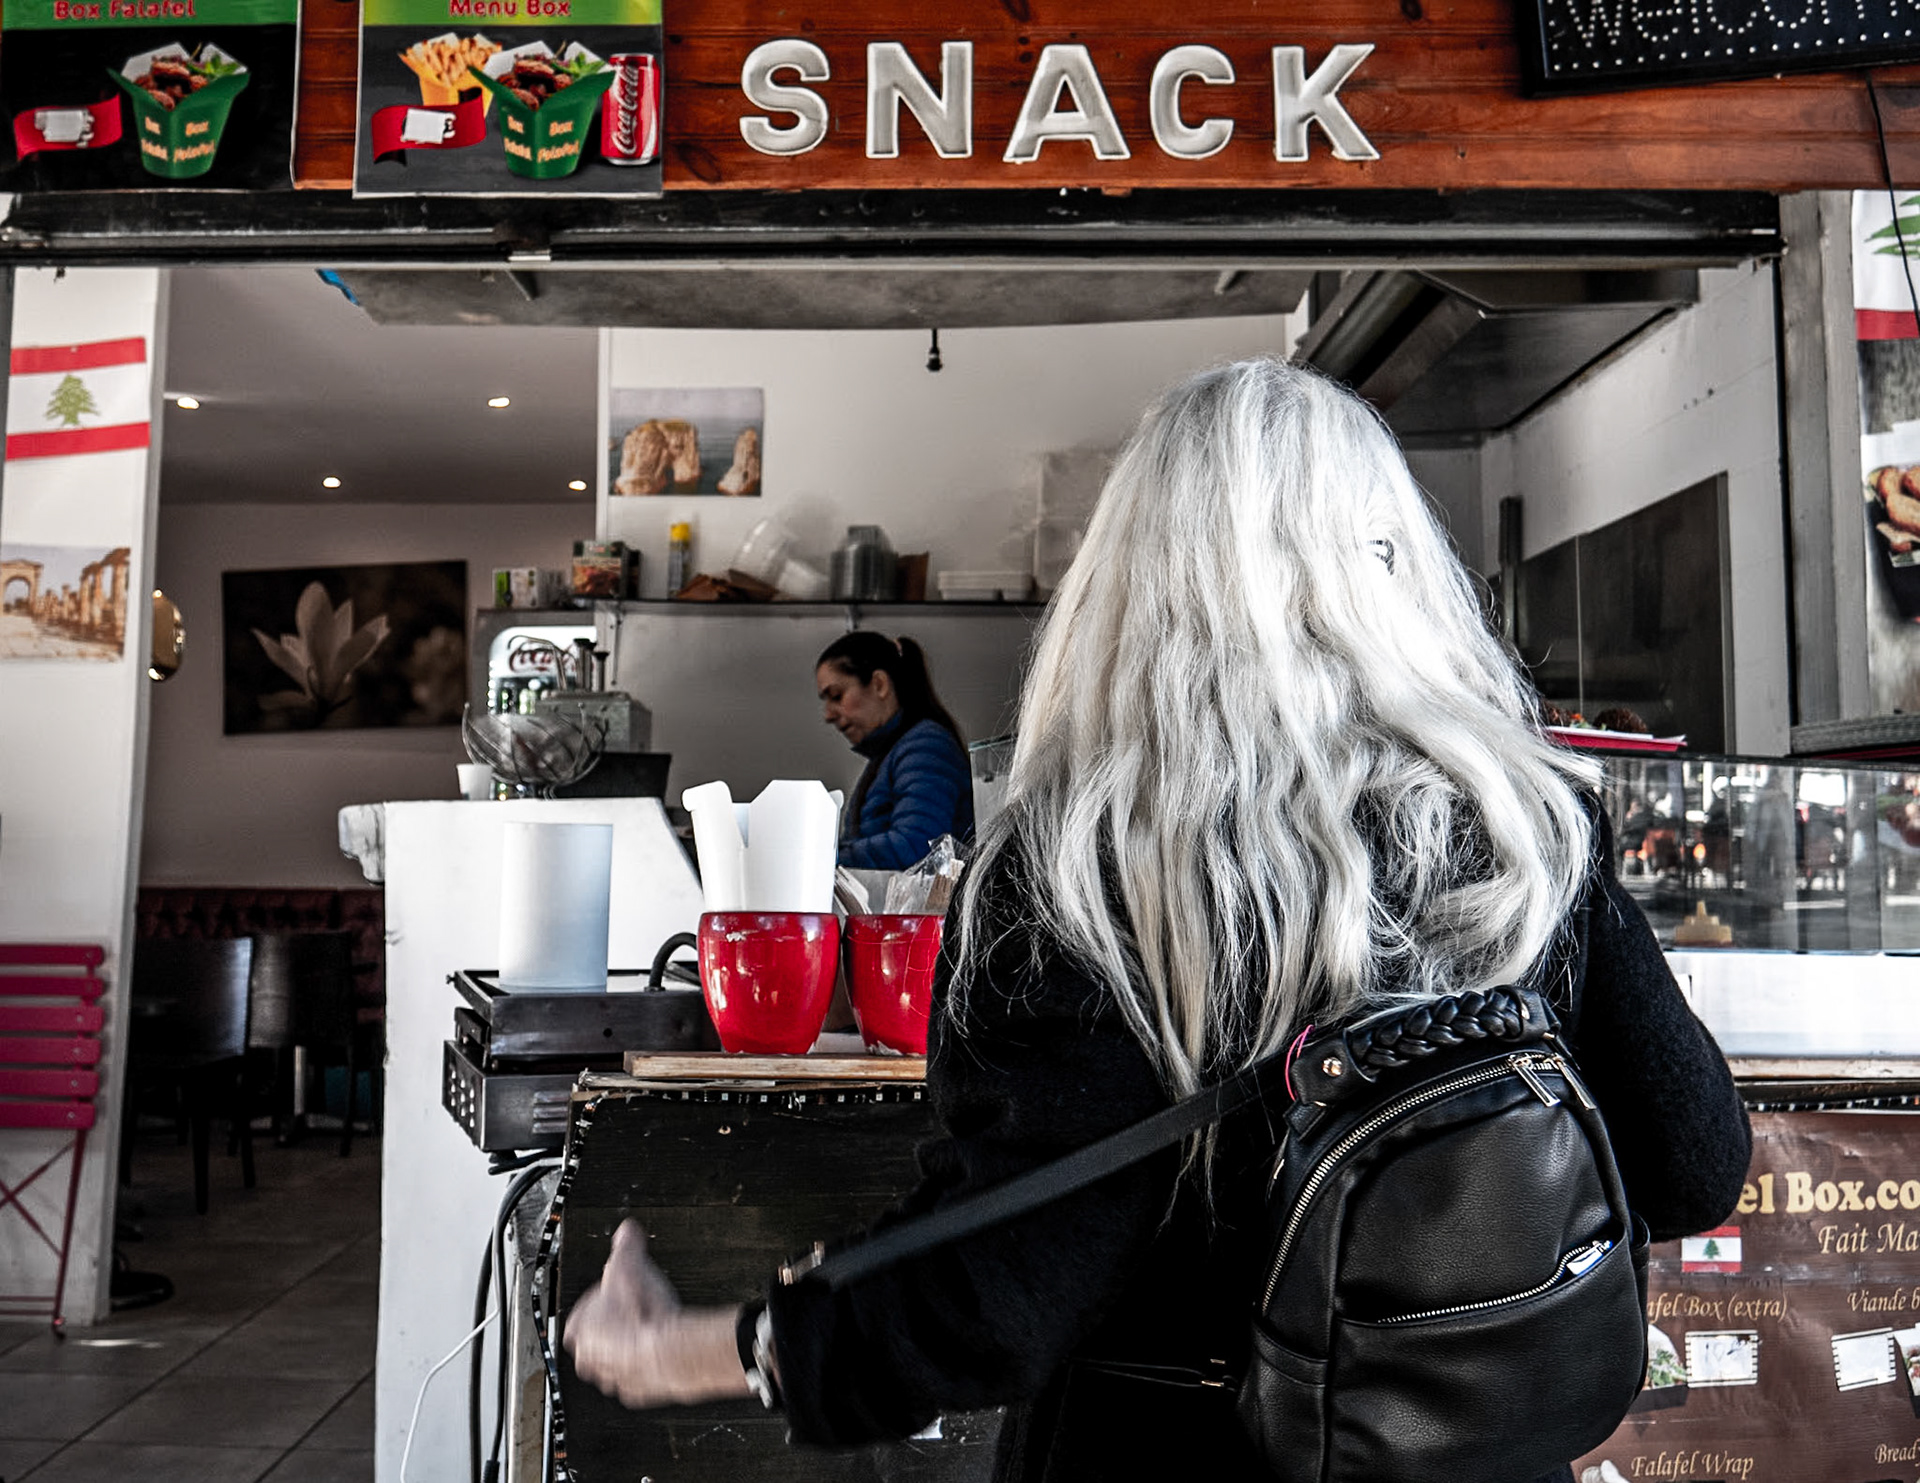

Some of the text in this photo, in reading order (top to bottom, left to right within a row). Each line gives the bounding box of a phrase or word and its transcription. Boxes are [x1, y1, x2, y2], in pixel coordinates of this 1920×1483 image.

[54, 0, 196, 19] Box Falafel
[450, 0, 571, 16] Menu Box
[739, 39, 1380, 164] SNACK
[1736, 1173, 1775, 1214] el
[1818, 1221, 1920, 1254] Fait Ma
[1647, 1291, 1787, 1324] afel Box (extra)
[1847, 1287, 1907, 1312] Viande
[1631, 1450, 1754, 1481] Falafel Wrap
